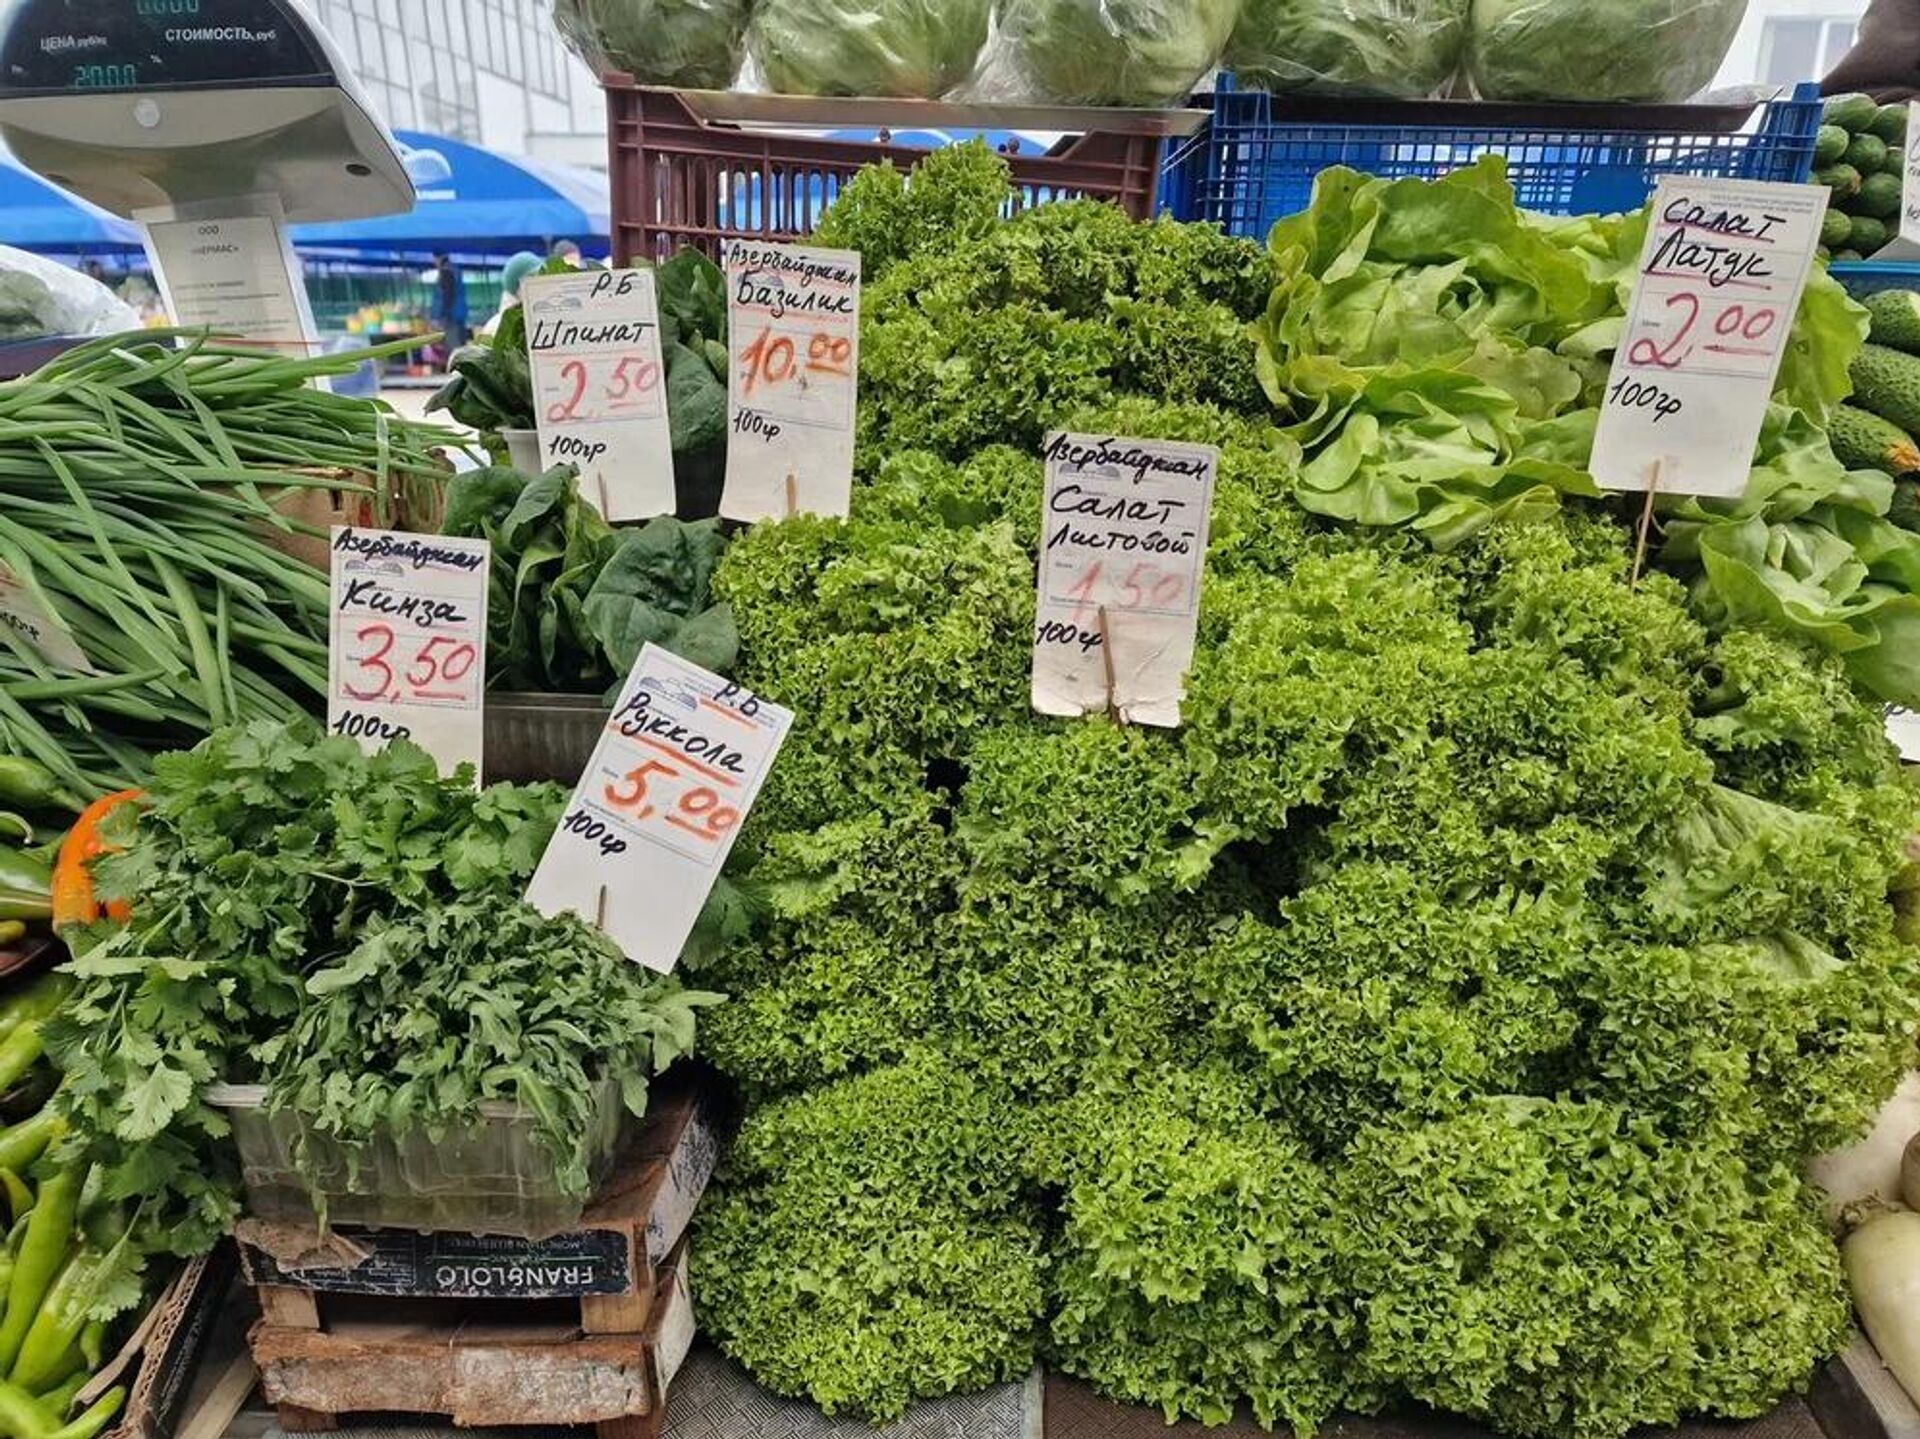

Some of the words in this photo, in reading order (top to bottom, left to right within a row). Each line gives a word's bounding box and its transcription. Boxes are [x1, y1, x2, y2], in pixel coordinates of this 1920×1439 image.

[40, 36, 75, 52] ЦЕНА
[1647, 227, 1774, 288] Латук
[736, 270, 854, 319] Базилик
[531, 319, 656, 351] Шпинат
[1609, 376, 1683, 423] 100гр
[547, 434, 607, 463] 100гр
[732, 410, 782, 443] 100гр
[1050, 484, 1186, 525] Салат
[339, 577, 467, 628] Кинза
[1036, 619, 1104, 653] 100гр
[613, 690, 746, 774] Руккола
[564, 808, 628, 856] 100гр
